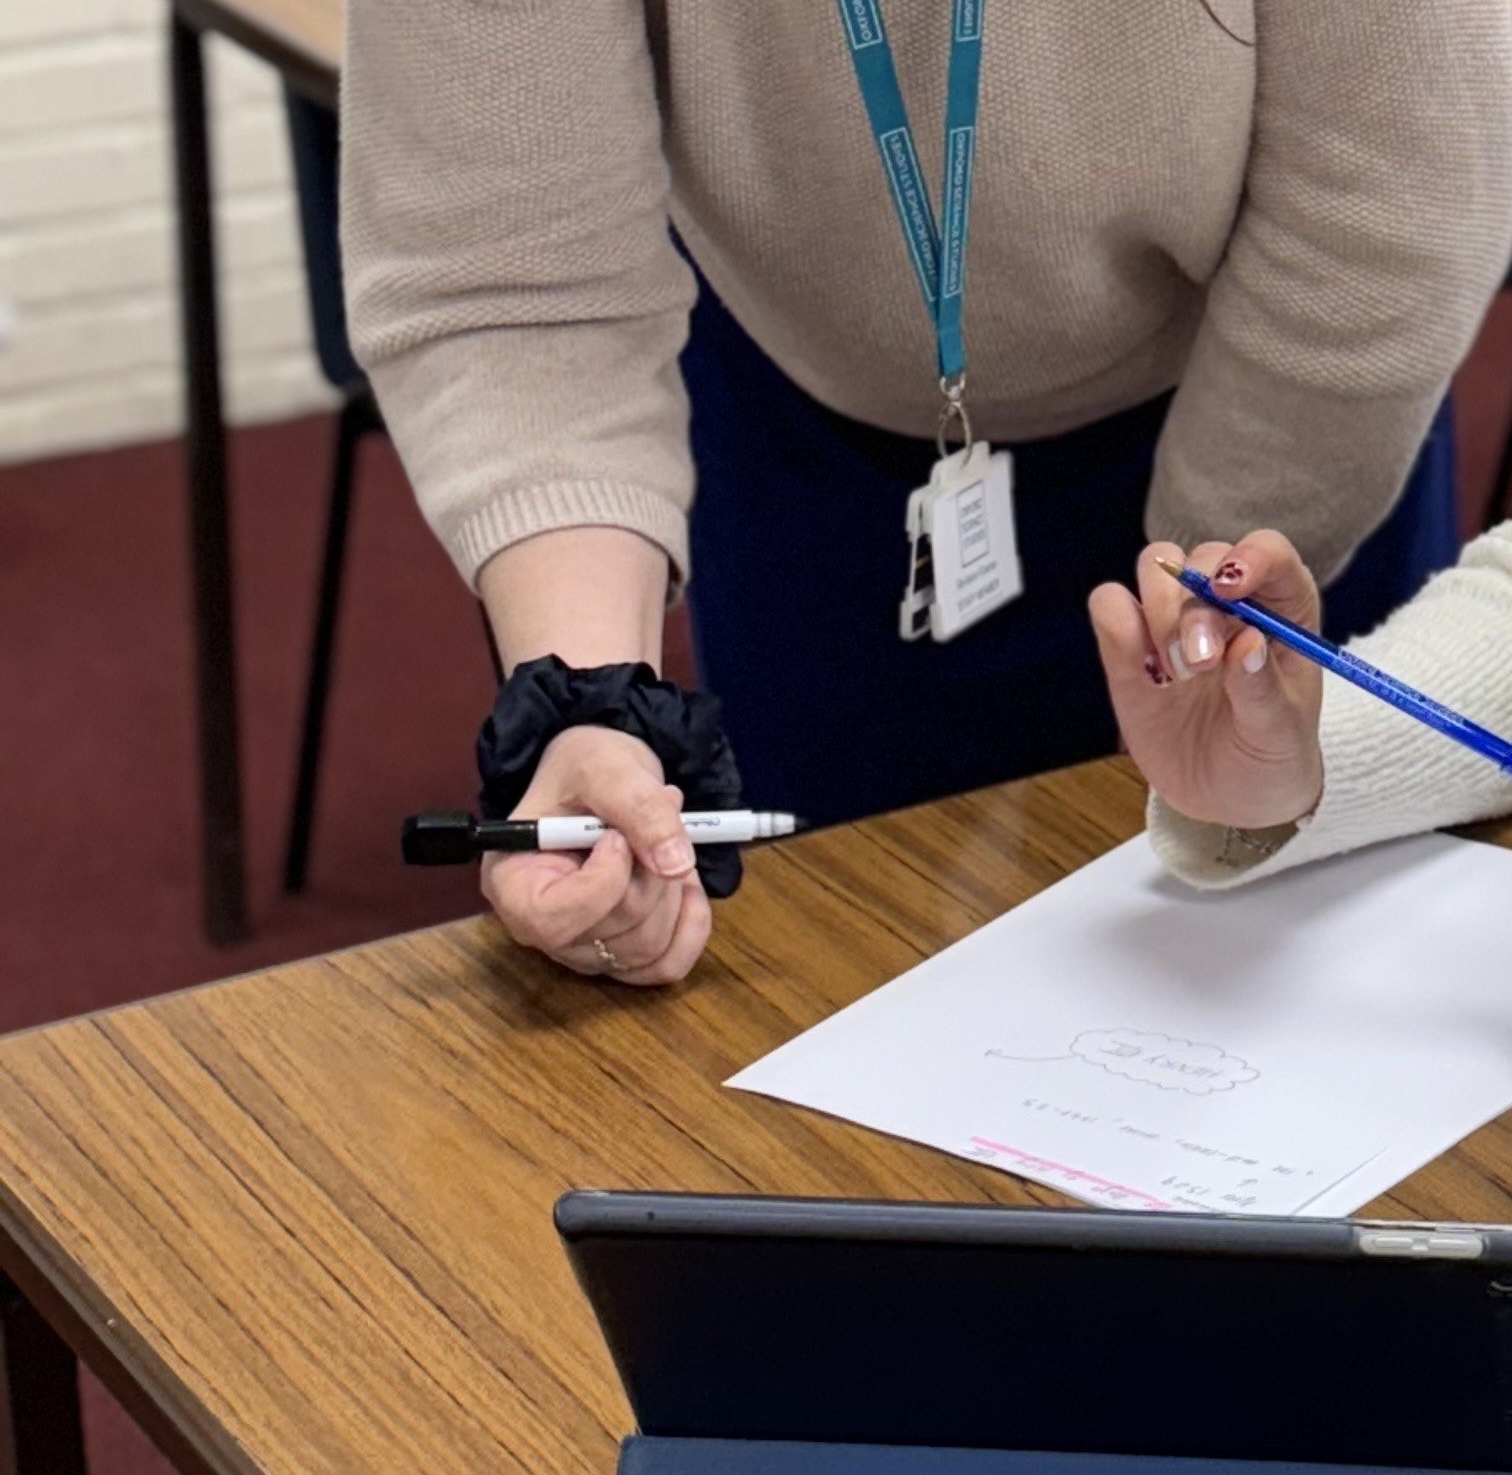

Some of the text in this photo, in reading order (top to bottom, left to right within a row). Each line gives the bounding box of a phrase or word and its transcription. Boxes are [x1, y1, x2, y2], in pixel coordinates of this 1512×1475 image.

[890, 136, 912, 190] STUDIES
[906, 189, 927, 240] SCIENCE
[950, 132, 967, 291] OXFORD SCIENCE STUDIES
